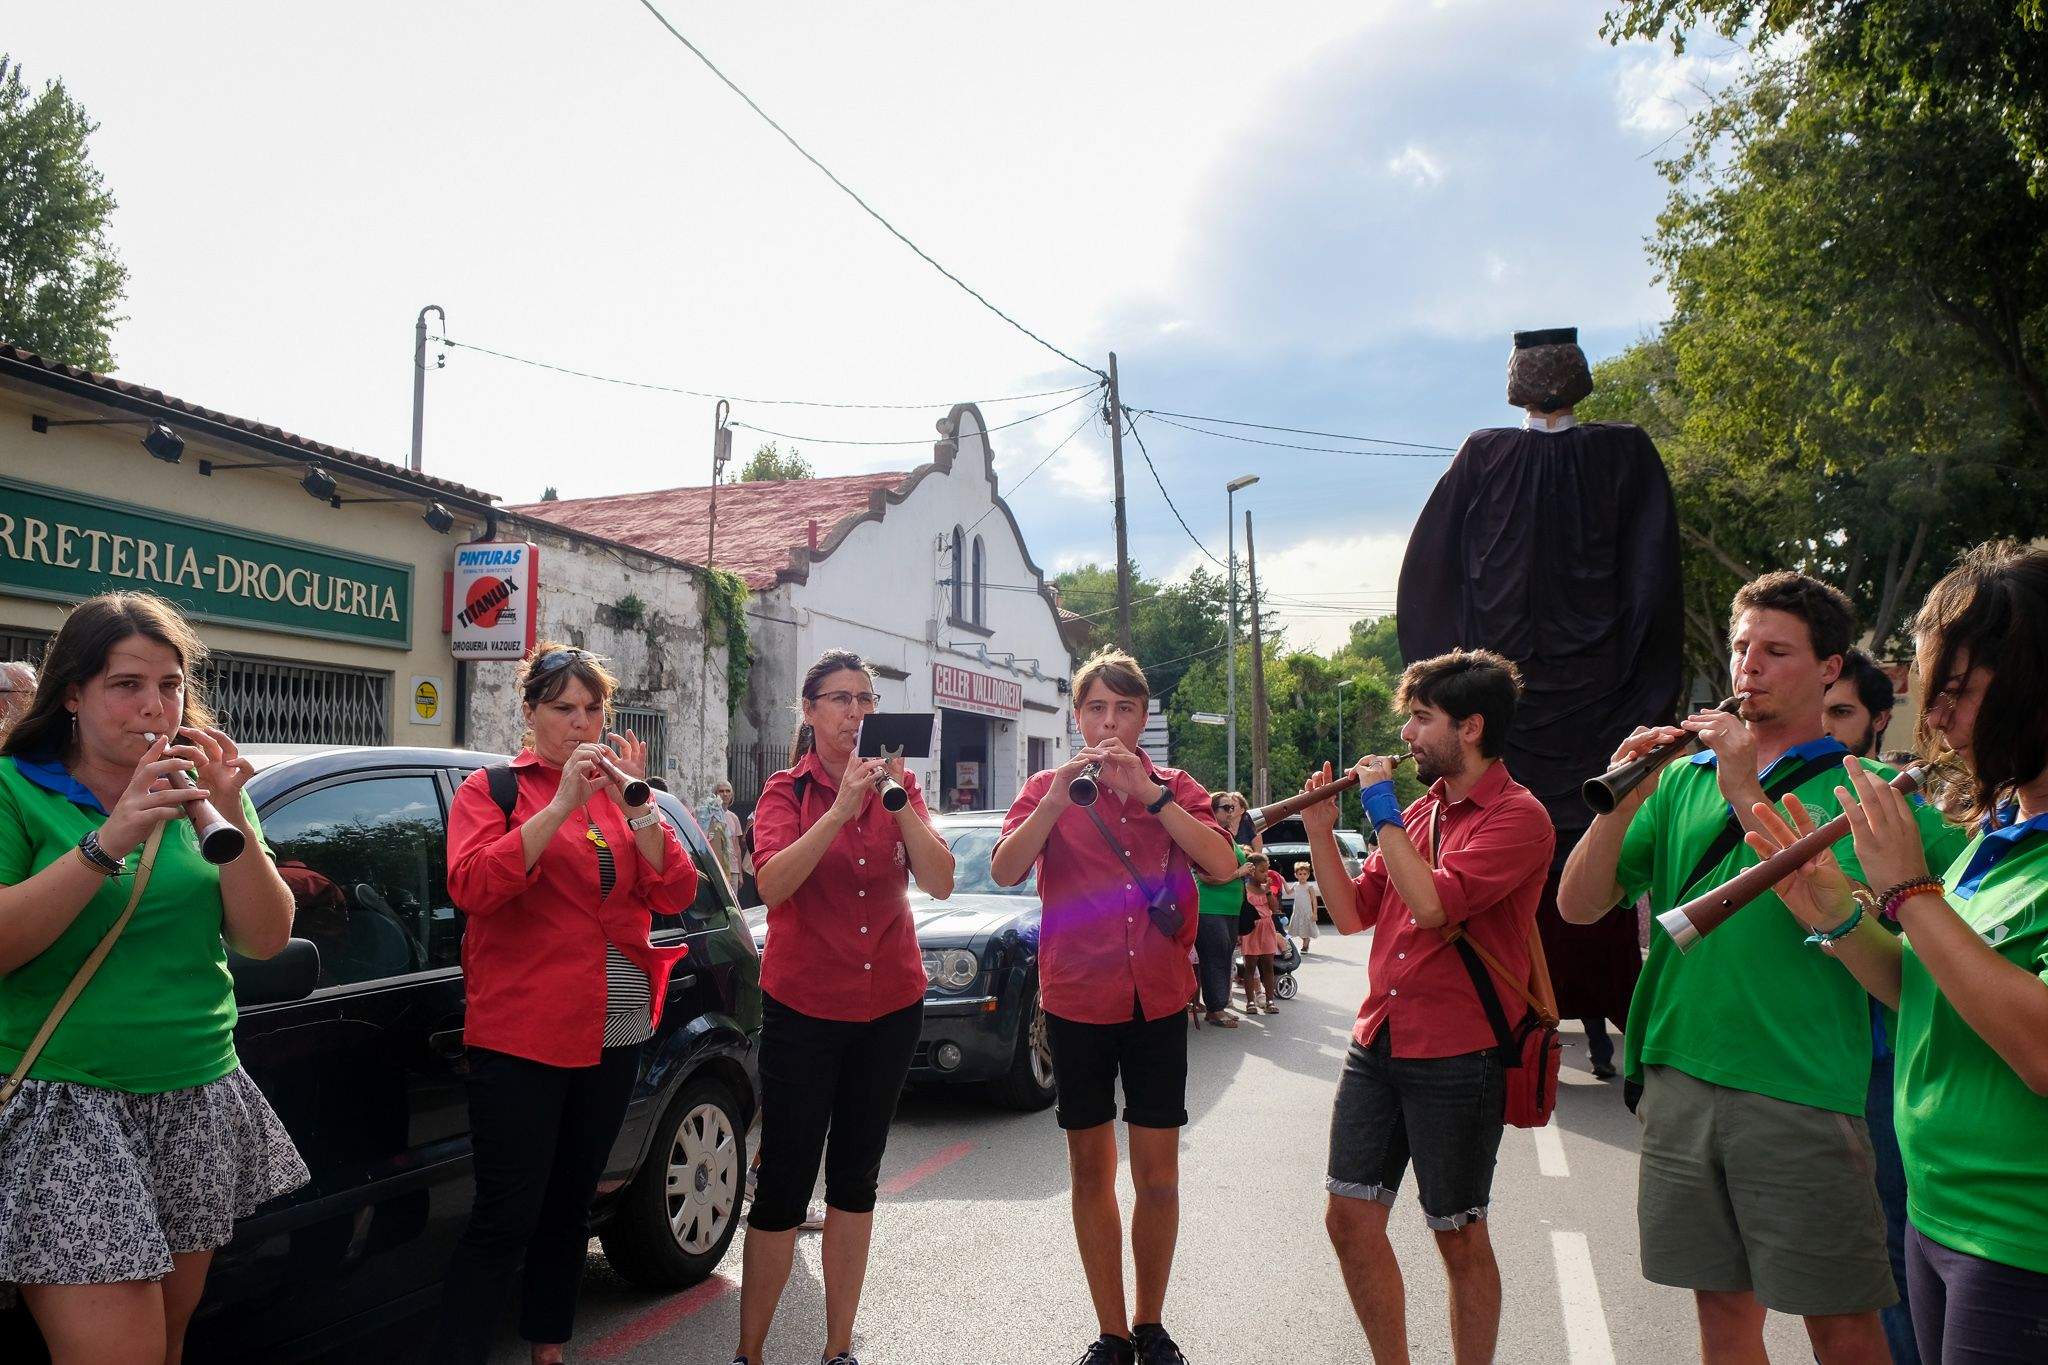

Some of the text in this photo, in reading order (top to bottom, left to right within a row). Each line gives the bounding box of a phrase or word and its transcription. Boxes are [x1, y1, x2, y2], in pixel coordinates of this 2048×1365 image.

[458, 549, 522, 566] PINTURAS
[457, 575, 520, 628] TITANLUX
[452, 640, 521, 651] DROGUERIA VAZQUEZ
[935, 665, 970, 701] CELLER
[972, 674, 1022, 711] VALLDOREIX
